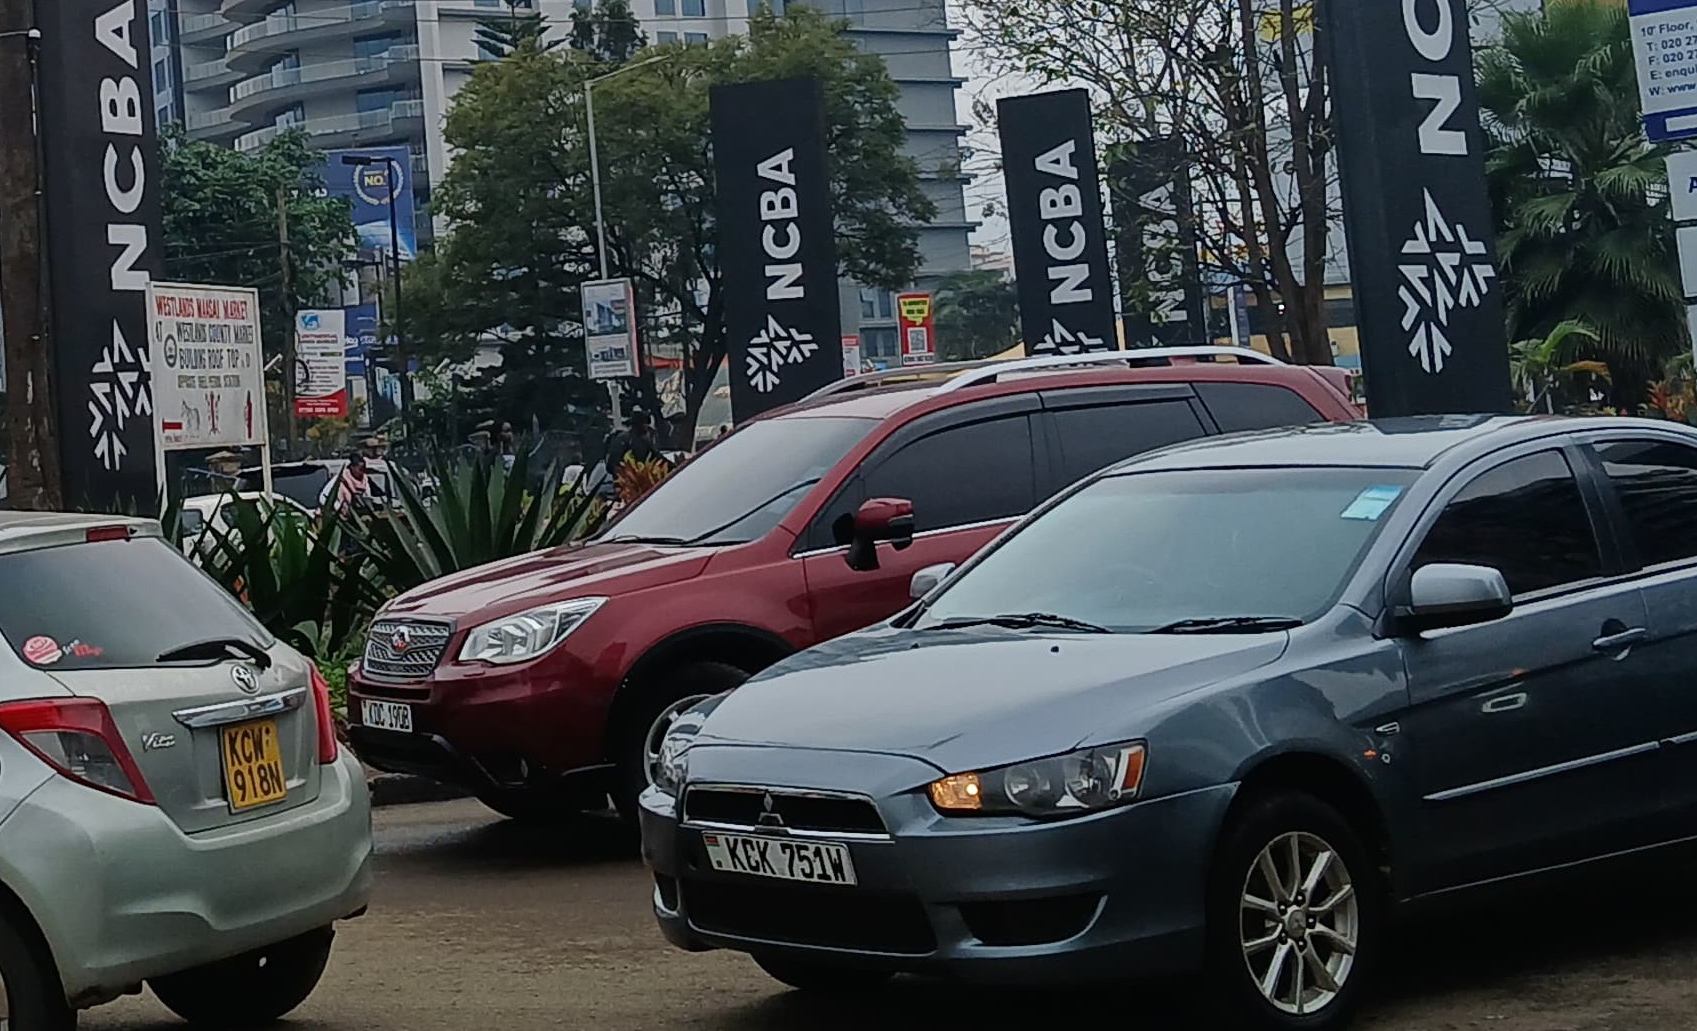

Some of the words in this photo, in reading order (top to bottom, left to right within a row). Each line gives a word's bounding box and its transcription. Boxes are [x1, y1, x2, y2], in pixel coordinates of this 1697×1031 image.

[1661, 37, 1682, 50] 020
[1663, 52, 1684, 64] 020
[757, 147, 805, 301] NCBA
[1034, 139, 1094, 305] NCBA
[227, 727, 266, 768] KCW
[234, 763, 284, 803] 918N
[726, 837, 782, 876] KCK
[781, 843, 845, 883] 751W
